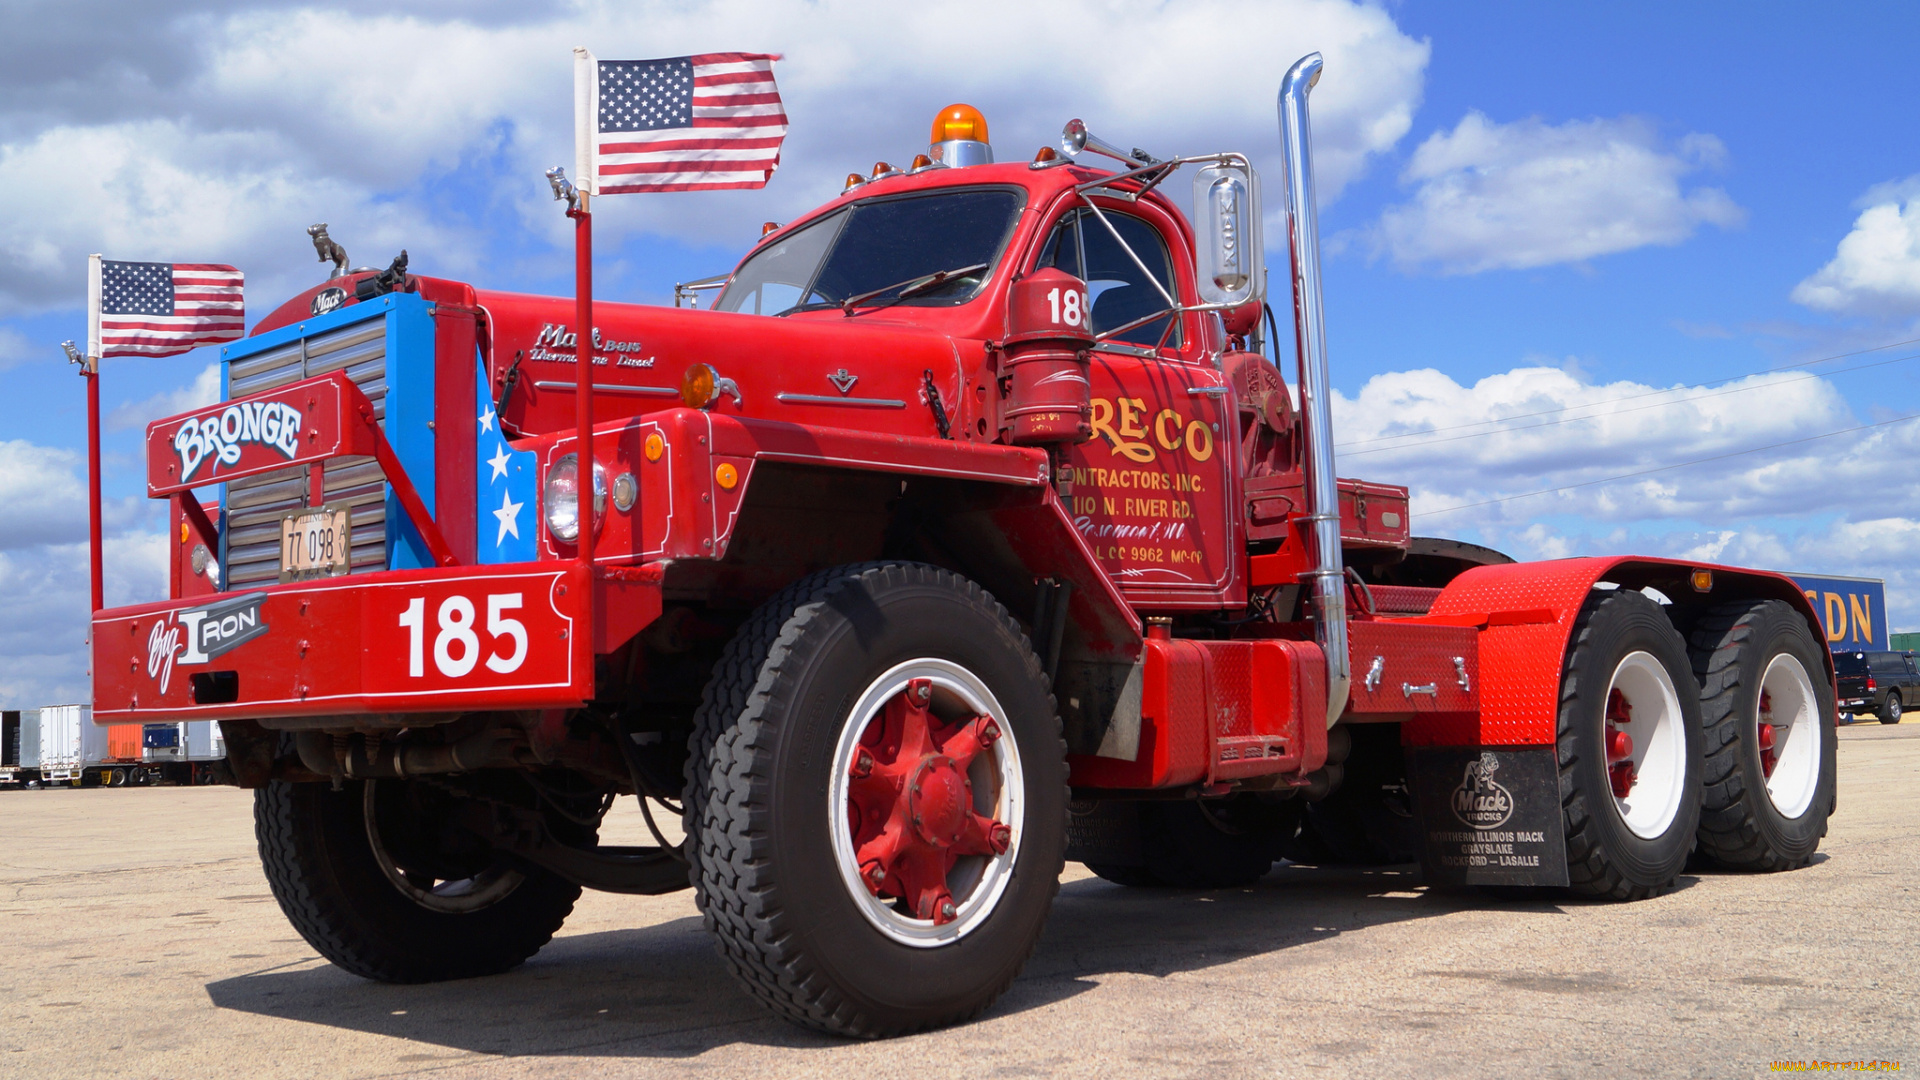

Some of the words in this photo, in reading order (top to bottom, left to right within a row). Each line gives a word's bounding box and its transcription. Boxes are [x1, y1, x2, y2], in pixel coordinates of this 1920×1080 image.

[1220, 199, 1237, 267] MACK
[313, 289, 341, 313] Mack
[535, 322, 603, 349] Mak
[174, 401, 302, 483] BRONGE
[1104, 497, 1119, 516] N.
[1126, 498, 1168, 517] RIVER
[1172, 500, 1194, 519] RD.
[288, 532, 302, 565] 77
[309, 528, 333, 562] 098
[1131, 547, 1163, 563] 9962
[1805, 590, 1872, 644] DN
[399, 592, 528, 678] 185
[147, 609, 184, 695] Big
[1457, 790, 1509, 812] Mack
[1466, 812, 1502, 821] TRUCKS
[1430, 831, 1475, 843] NORTHERN
[1476, 832, 1514, 843] ILLINOIS
[1517, 832, 1544, 843] MACK
[1461, 843, 1513, 855] GRAYSLAKE
[1441, 855, 1487, 867] ROCKFORD
[1500, 855, 1539, 867] LASALLE
